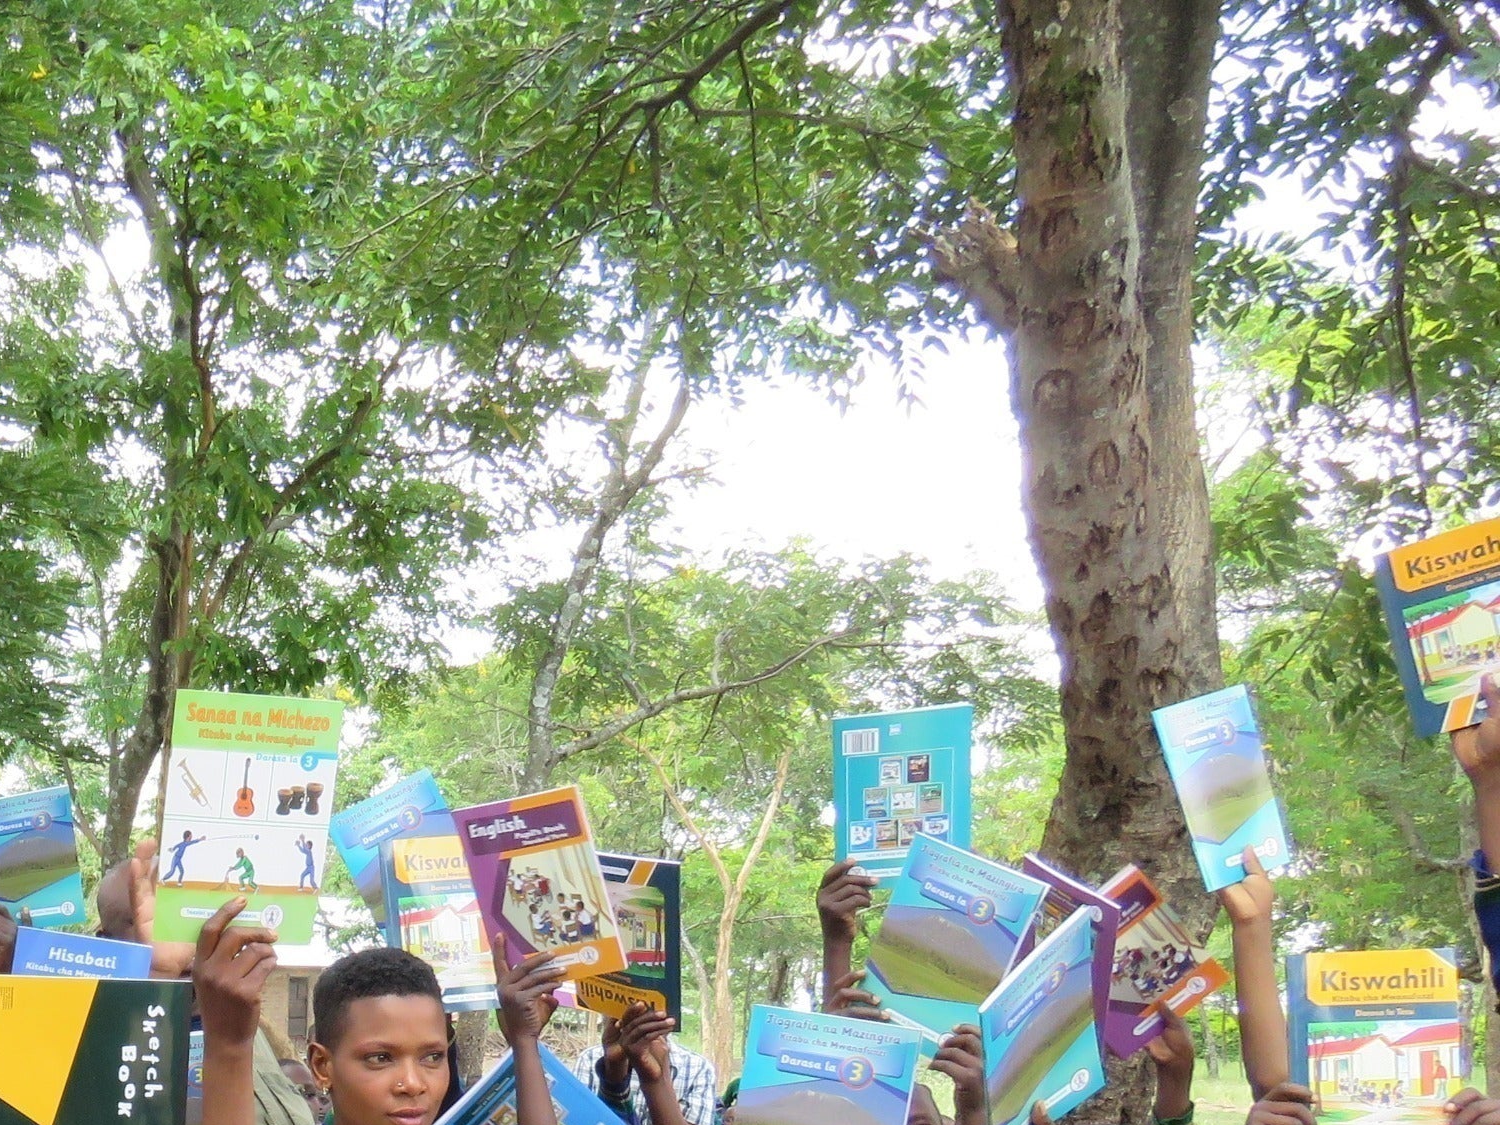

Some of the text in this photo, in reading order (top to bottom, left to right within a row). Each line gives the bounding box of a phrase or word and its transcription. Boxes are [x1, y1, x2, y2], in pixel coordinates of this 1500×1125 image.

[186, 701, 331, 732] Sanaa na Michezo
[198, 728, 315, 748] Kitabu cha Mwanafunzi
[1222, 724, 1231, 739] 3
[255, 752, 287, 762] Darasa
[303, 755, 314, 768] 3
[38, 815, 46, 827] 3
[362, 827, 390, 846] Darasa
[404, 810, 415, 825] 3
[468, 815, 528, 840] English
[976, 868, 1026, 894] Mazingira
[923, 881, 989, 918] Darasa la 3
[25, 961, 73, 977] Kitabu cha
[48, 946, 117, 970] Hisabati
[1050, 969, 1061, 989] 3
[1319, 966, 1446, 992] Kiswahili
[766, 1012, 901, 1045] Jiografia na Mazingira
[811, 1037, 828, 1048] cha
[117, 1004, 166, 1118] Sketch Book
[780, 1054, 865, 1082] Darasa la 3
[194, 1067, 204, 1083] 3
